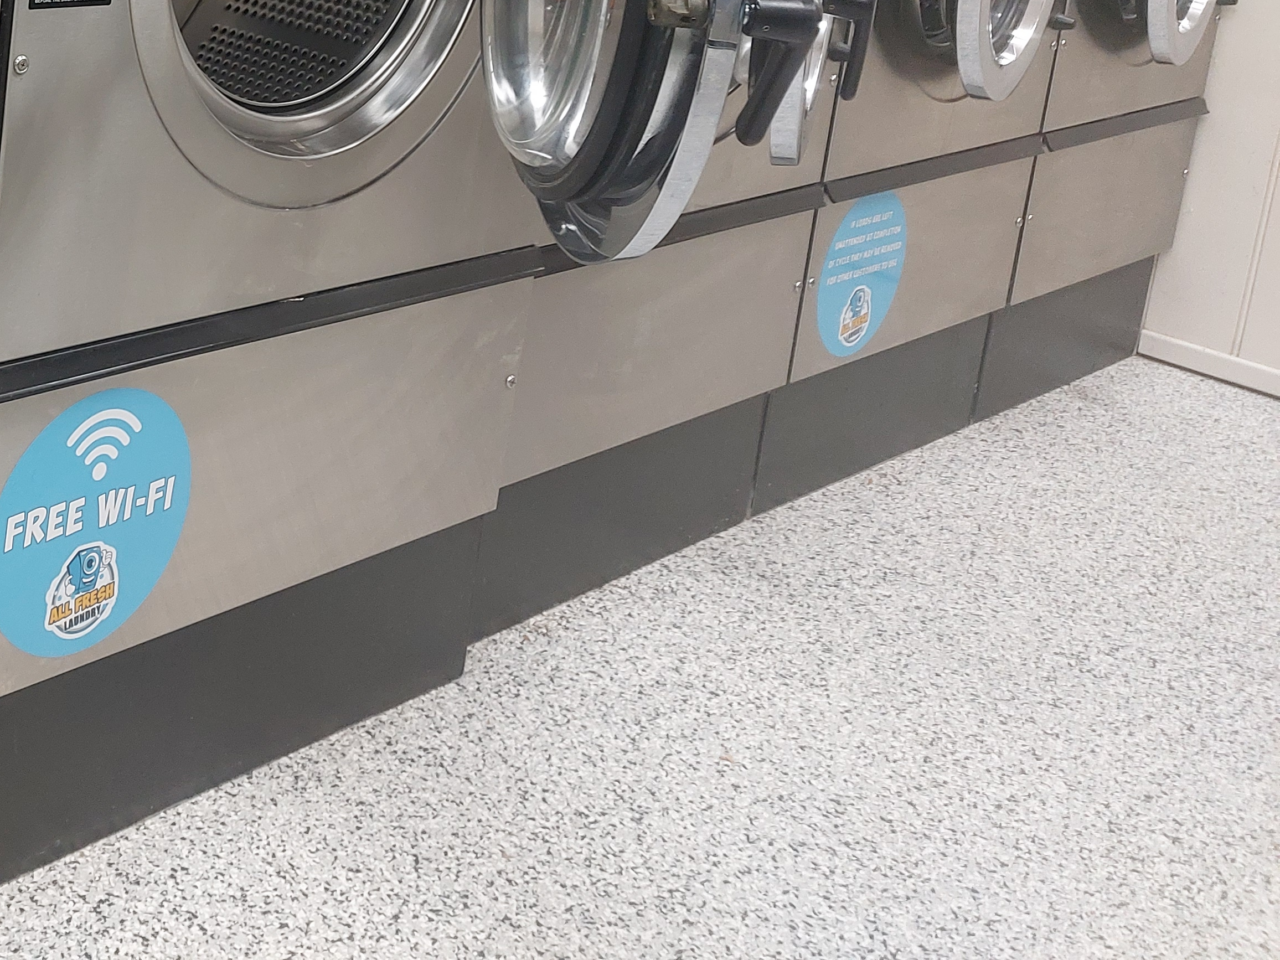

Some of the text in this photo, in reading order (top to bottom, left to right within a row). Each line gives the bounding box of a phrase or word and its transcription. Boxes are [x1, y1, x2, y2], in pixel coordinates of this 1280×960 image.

[4, 475, 176, 554] FREE WI-FI
[48, 581, 115, 625] ALL FRESH
[64, 605, 101, 631] LAUNDRY
